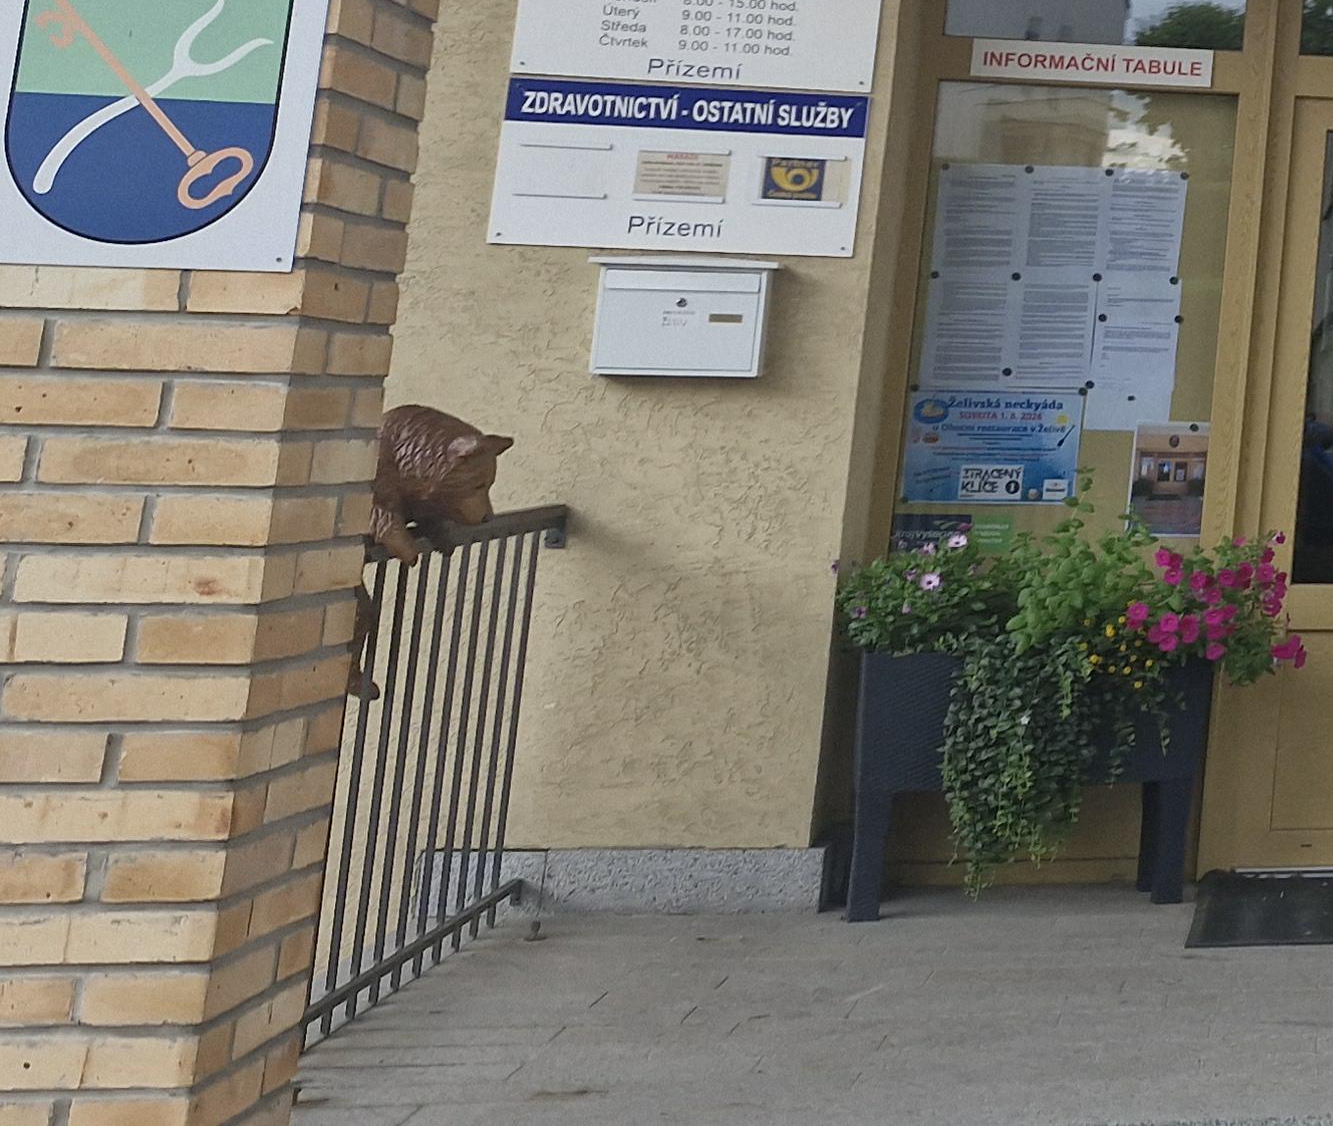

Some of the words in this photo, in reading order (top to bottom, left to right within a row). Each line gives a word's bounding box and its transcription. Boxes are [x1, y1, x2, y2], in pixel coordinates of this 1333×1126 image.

[603, 4, 640, 20] Úterý
[682, 10, 712, 21] 9.00
[727, 12, 763, 25] 11.00
[768, 15, 796, 26] hod.
[770, 0, 799, 12] hod.
[600, 19, 647, 34] Středa
[680, 25, 710, 36] 8.00
[726, 27, 762, 40] 17.00
[767, 30, 796, 41] hod.
[598, 33, 648, 49] Čtvrtek
[678, 40, 708, 51] 9.00
[723, 42, 760, 54] 11.00
[764, 44, 793, 56] hod.
[647, 58, 743, 80] Přízemí
[982, 49, 1117, 73] INFORMAČNÍ
[1122, 57, 1204, 78] TABULE
[520, 90, 680, 121] ZDRAVOTNICTVÍ
[692, 100, 775, 126] OSTATNÍ
[776, 101, 854, 130] SLUŽBY
[626, 215, 725, 238] Přízemí
[948, 396, 1001, 409] Želivská
